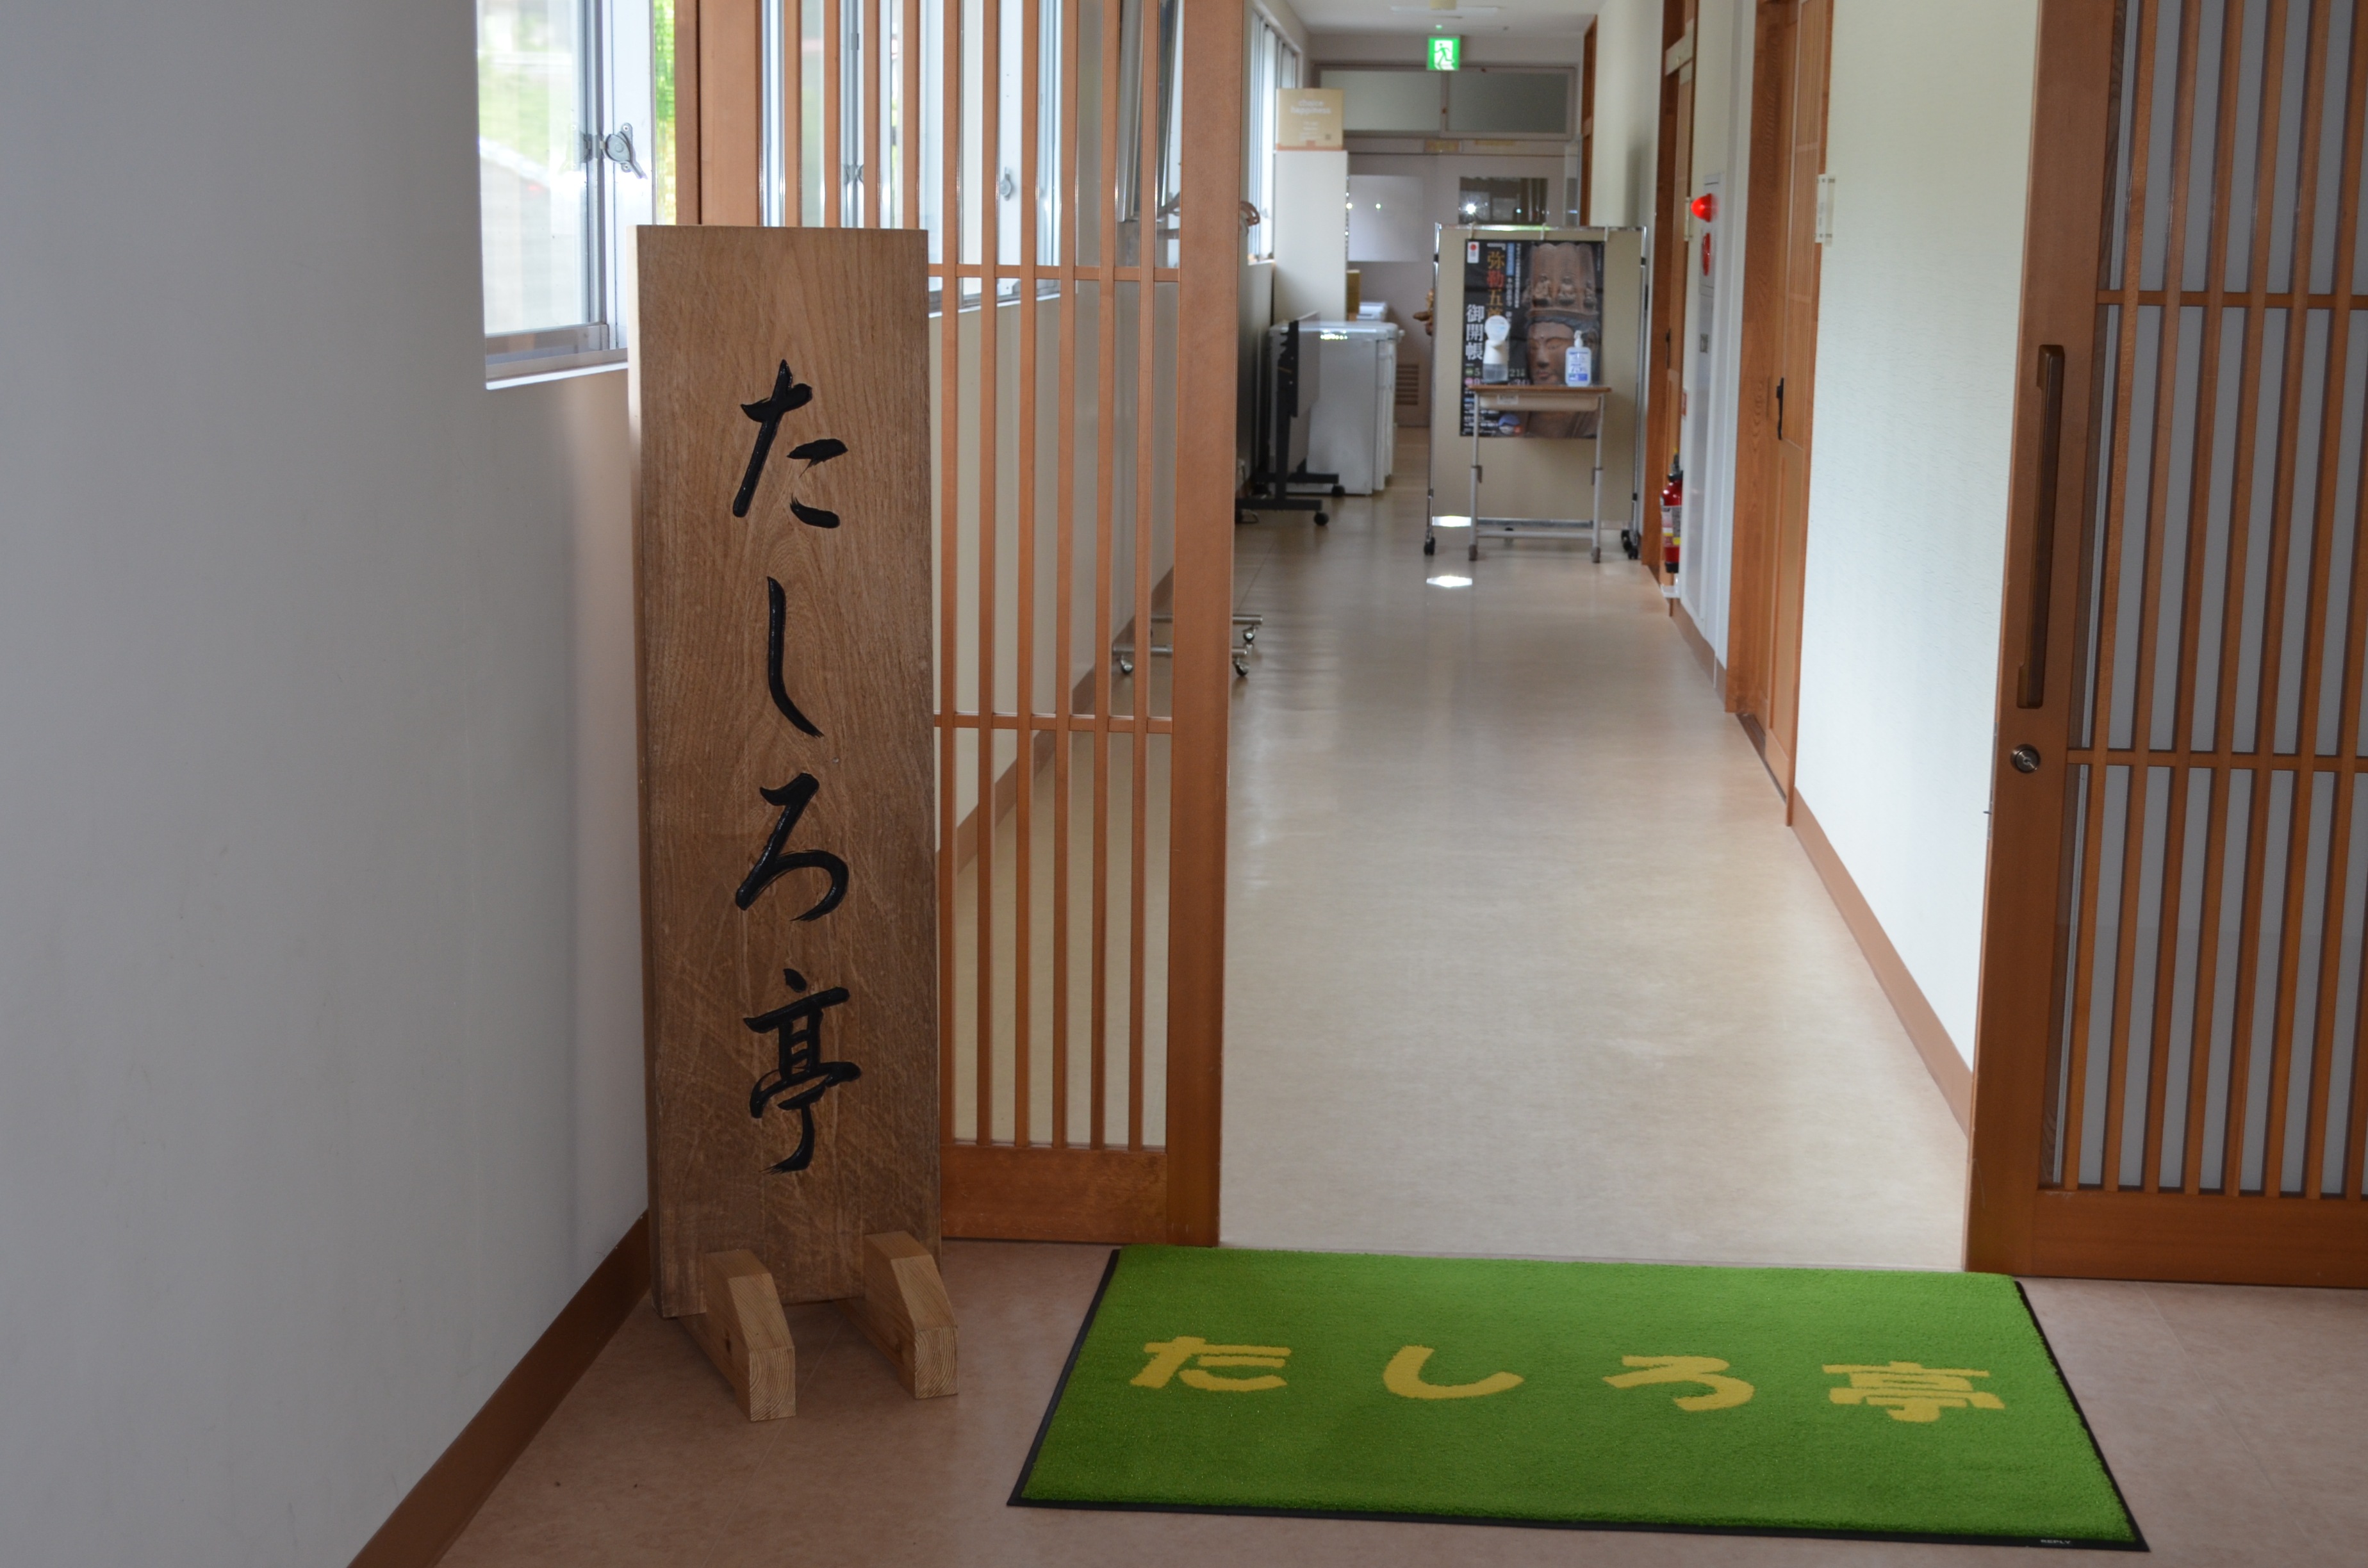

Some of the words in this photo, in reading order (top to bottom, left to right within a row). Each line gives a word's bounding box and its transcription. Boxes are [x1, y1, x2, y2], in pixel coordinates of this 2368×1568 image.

[1465, 304, 1485, 361] 御開帳
[732, 359, 861, 1174] たしろ亭
[1130, 1336, 2005, 1423] たしろ亭
